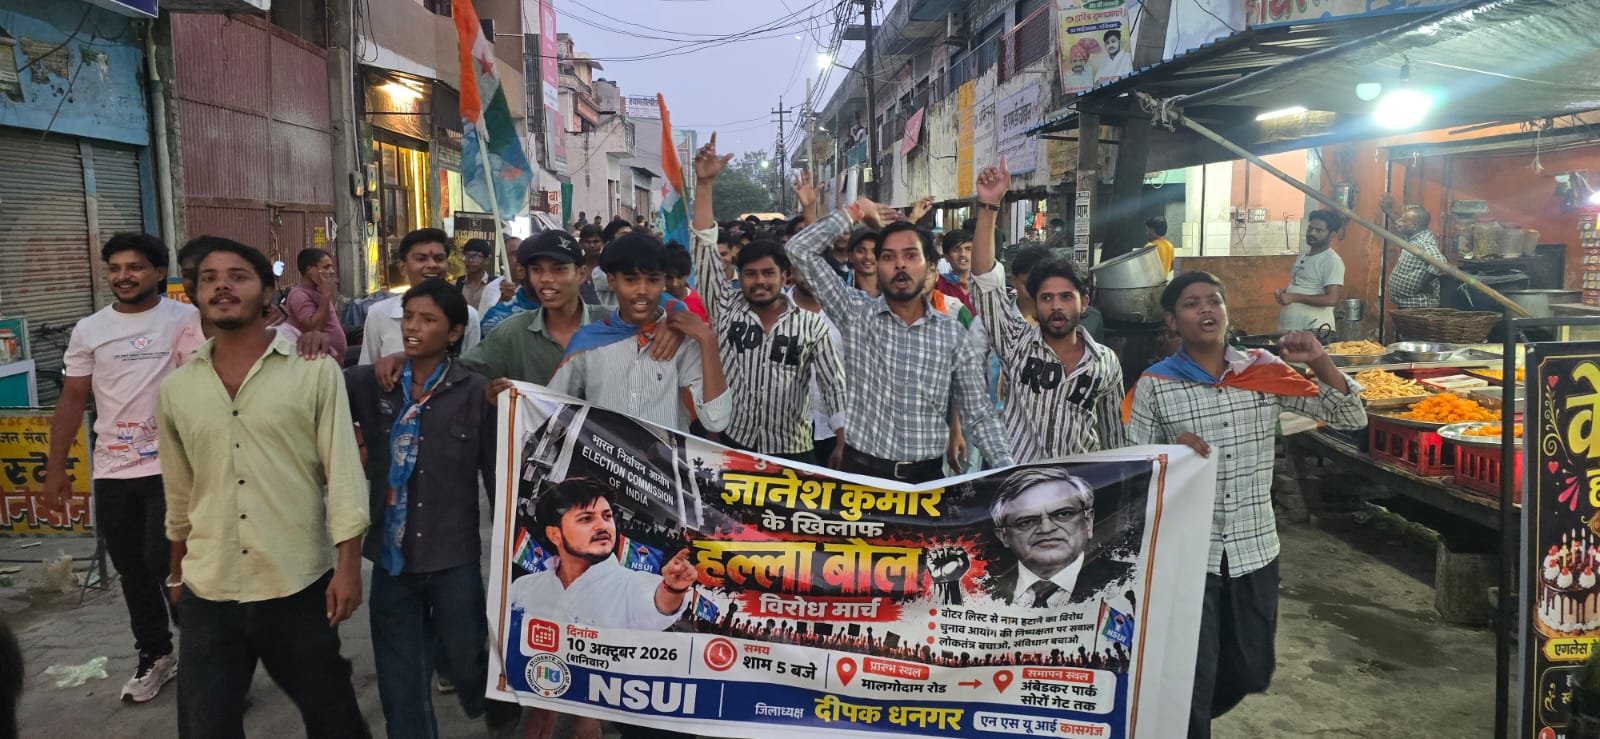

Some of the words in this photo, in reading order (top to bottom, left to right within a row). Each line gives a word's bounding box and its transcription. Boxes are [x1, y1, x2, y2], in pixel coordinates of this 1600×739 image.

[592, 434, 615, 455] भारत
[617, 447, 646, 475] निर्वाचन
[649, 469, 670, 489] आयोग
[582, 446, 626, 478] ELECTION
[628, 471, 674, 506] COMMISSION
[609, 477, 622, 489] OF
[626, 486, 649, 507] INDIA
[720, 469, 836, 510] ज्ञानेश
[839, 483, 945, 521] कुमार
[761, 509, 786, 531] के
[791, 511, 885, 537] खिलाफ
[630, 560, 653, 572] NSUI
[692, 539, 819, 593] हल्ला
[821, 537, 922, 595] बोल
[759, 592, 828, 617] विरोध
[832, 597, 883, 618] मार्च
[941, 607, 963, 619] वोटर
[965, 610, 988, 622] लिस्ट
[990, 612, 999, 623] से
[1001, 616, 1018, 625] नाम
[1021, 616, 1043, 626] हटाने
[1045, 615, 1057, 623] का
[1060, 611, 1084, 622] विरोध
[566, 624, 598, 639] दिनांक
[940, 623, 966, 634] चुनाव
[968, 626, 997, 637] आयोग
[1000, 628, 1013, 637] की
[1069, 623, 1095, 632] सवाल
[1106, 628, 1127, 643] NSUI
[567, 637, 585, 652] 10
[590, 642, 637, 662] अक्टूबर
[640, 647, 678, 661] 2026
[744, 644, 770, 655] समय
[939, 635, 976, 649] लोकतंत्र
[978, 640, 1010, 649] बचाओ,
[1013, 638, 1049, 647] संविधान
[1051, 634, 1079, 644] बचाओ
[1554, 640, 1588, 656] एगलेस
[566, 653, 609, 669] (शनिवार)
[743, 655, 772, 671] शाम
[776, 662, 786, 674] 5
[791, 663, 817, 680] बजे
[899, 665, 922, 678] स्थल
[1027, 669, 1063, 679] समापन
[1065, 671, 1089, 681] स्थल
[589, 673, 697, 714] NSUI
[861, 678, 924, 693] मालगोदाम
[927, 681, 948, 693] रोड
[1020, 679, 1069, 694] अंबेडकर
[1072, 684, 1098, 697] पार्क
[755, 703, 804, 719] जिलाध्यक्ष
[1020, 693, 1050, 706] सोरों
[1052, 696, 1070, 709] गेट
[1073, 701, 1096, 711] तक
[814, 694, 883, 724] दीपक
[888, 704, 965, 731] धनगर
[980, 716, 998, 728] एन
[1000, 717, 1019, 729] एस
[1022, 720, 1034, 734] यू
[1035, 719, 1058, 732] आई
[1059, 722, 1104, 736] कासगंज
